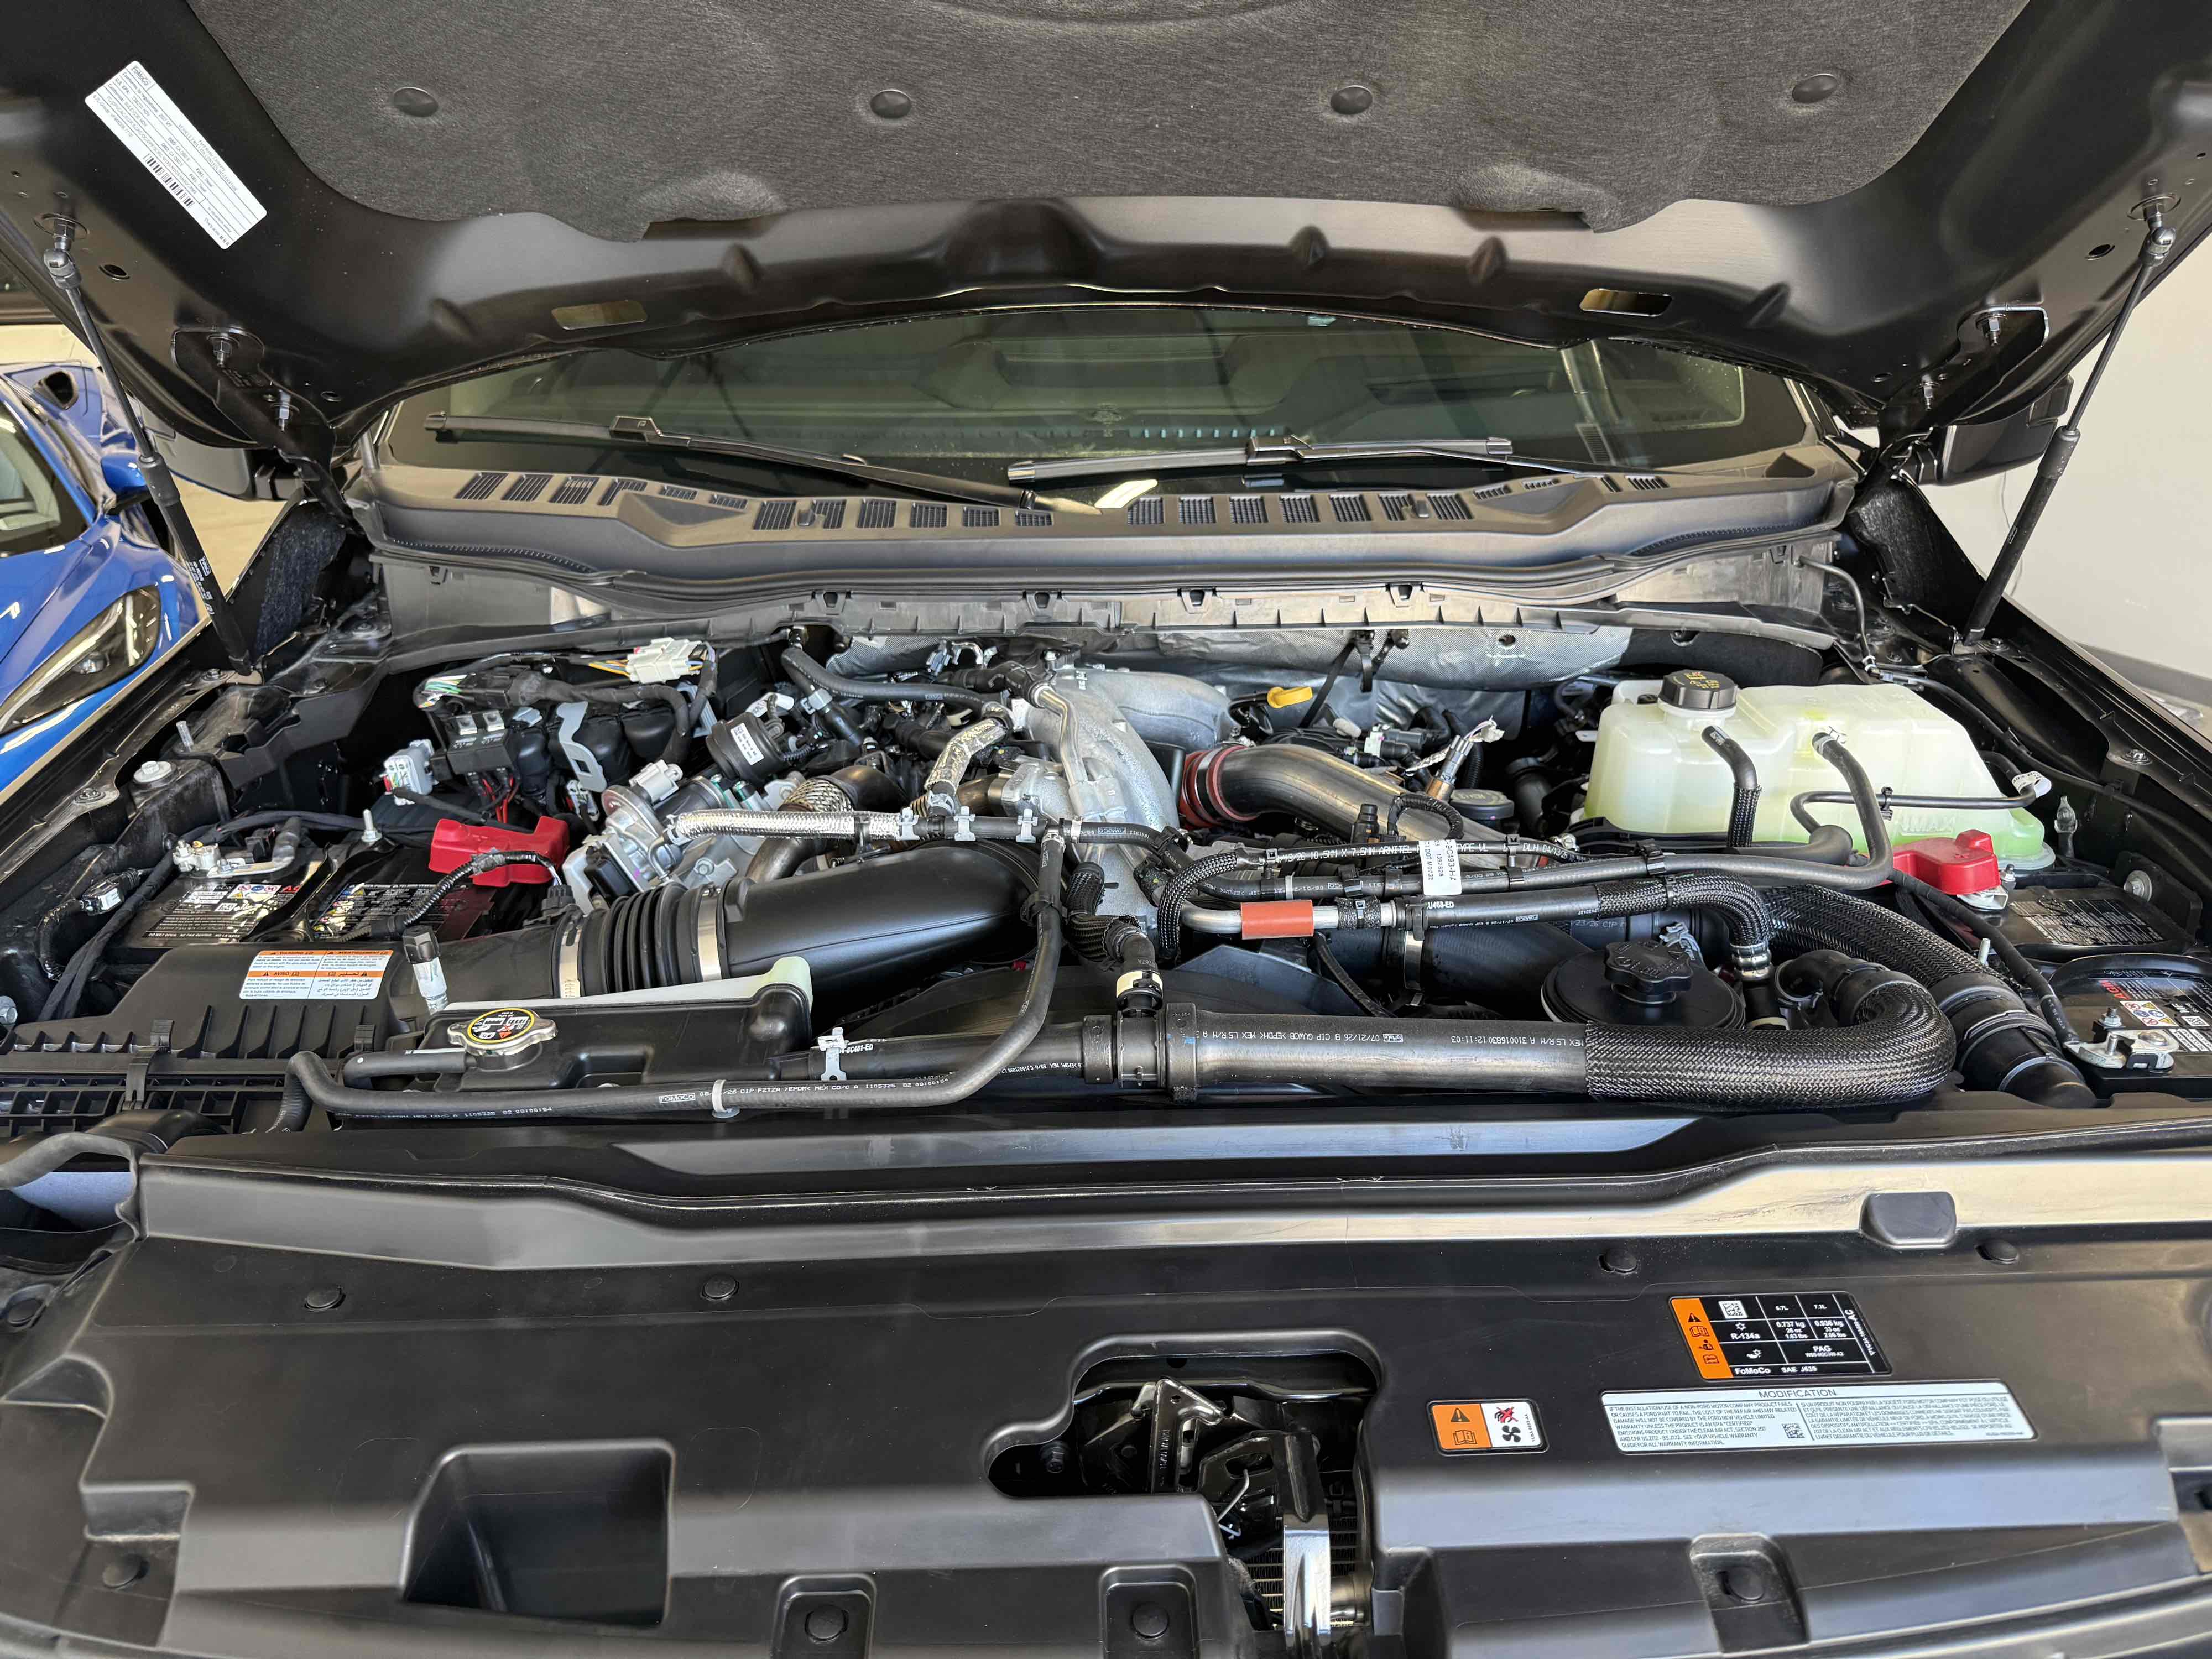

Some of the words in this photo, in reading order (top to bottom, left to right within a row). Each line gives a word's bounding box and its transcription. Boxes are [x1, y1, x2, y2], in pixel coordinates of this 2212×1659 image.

[1378, 845, 1412, 855] ARNITEL
[1242, 1031, 1256, 1040] MEX
[1345, 1034, 1380, 1042] 07/21/26
[1569, 1039, 1584, 1047] MEX
[1759, 1388, 1837, 1399] MODIFICATION
